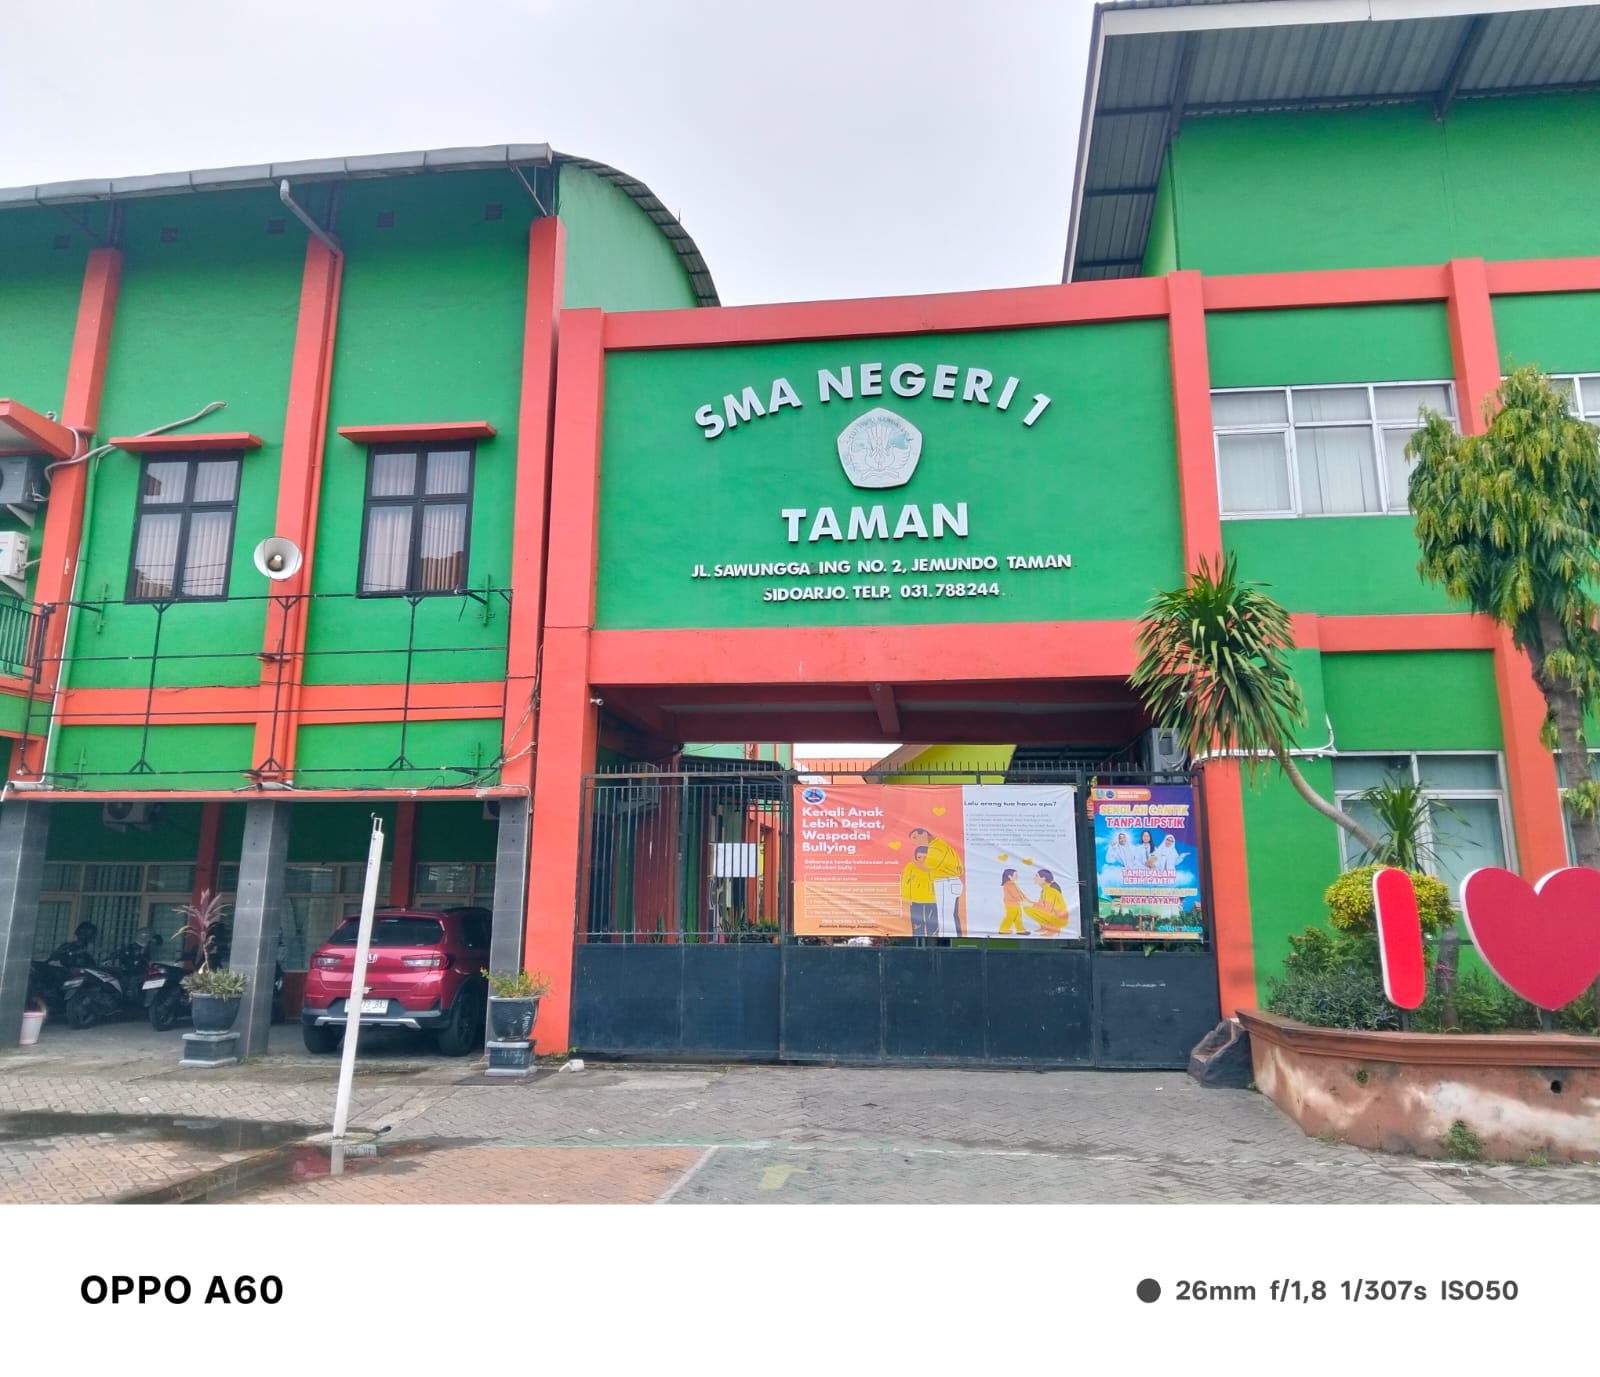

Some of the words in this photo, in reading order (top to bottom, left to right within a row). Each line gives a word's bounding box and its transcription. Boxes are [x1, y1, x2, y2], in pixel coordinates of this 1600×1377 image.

[695, 378, 802, 438] SMA
[818, 363, 1019, 410] NEGERI
[1023, 393, 1051, 427] 1
[781, 502, 968, 542] TAMAN
[692, 564, 711, 578] JL.
[857, 559, 888, 574] NO.
[892, 559, 908, 575] 2,
[1007, 554, 1072, 570] TAMAN
[763, 585, 849, 601] SIDOARJO.
[853, 584, 892, 599] TELP.
[802, 807, 845, 817] Kenali
[848, 807, 884, 817] Anak
[1099, 804, 1149, 816] SEKOLAH
[1149, 804, 1189, 816] CANTIK
[802, 818, 838, 828] Lebih
[841, 818, 885, 830] Dekat,
[1105, 817, 1143, 828] TANPA
[1144, 816, 1185, 828] LIPSTIK
[802, 830, 871, 843] Waspadai
[802, 842, 856, 855] Bullying
[1121, 896, 1147, 905] BUKAN
[1372, 867, 1425, 1010] I
